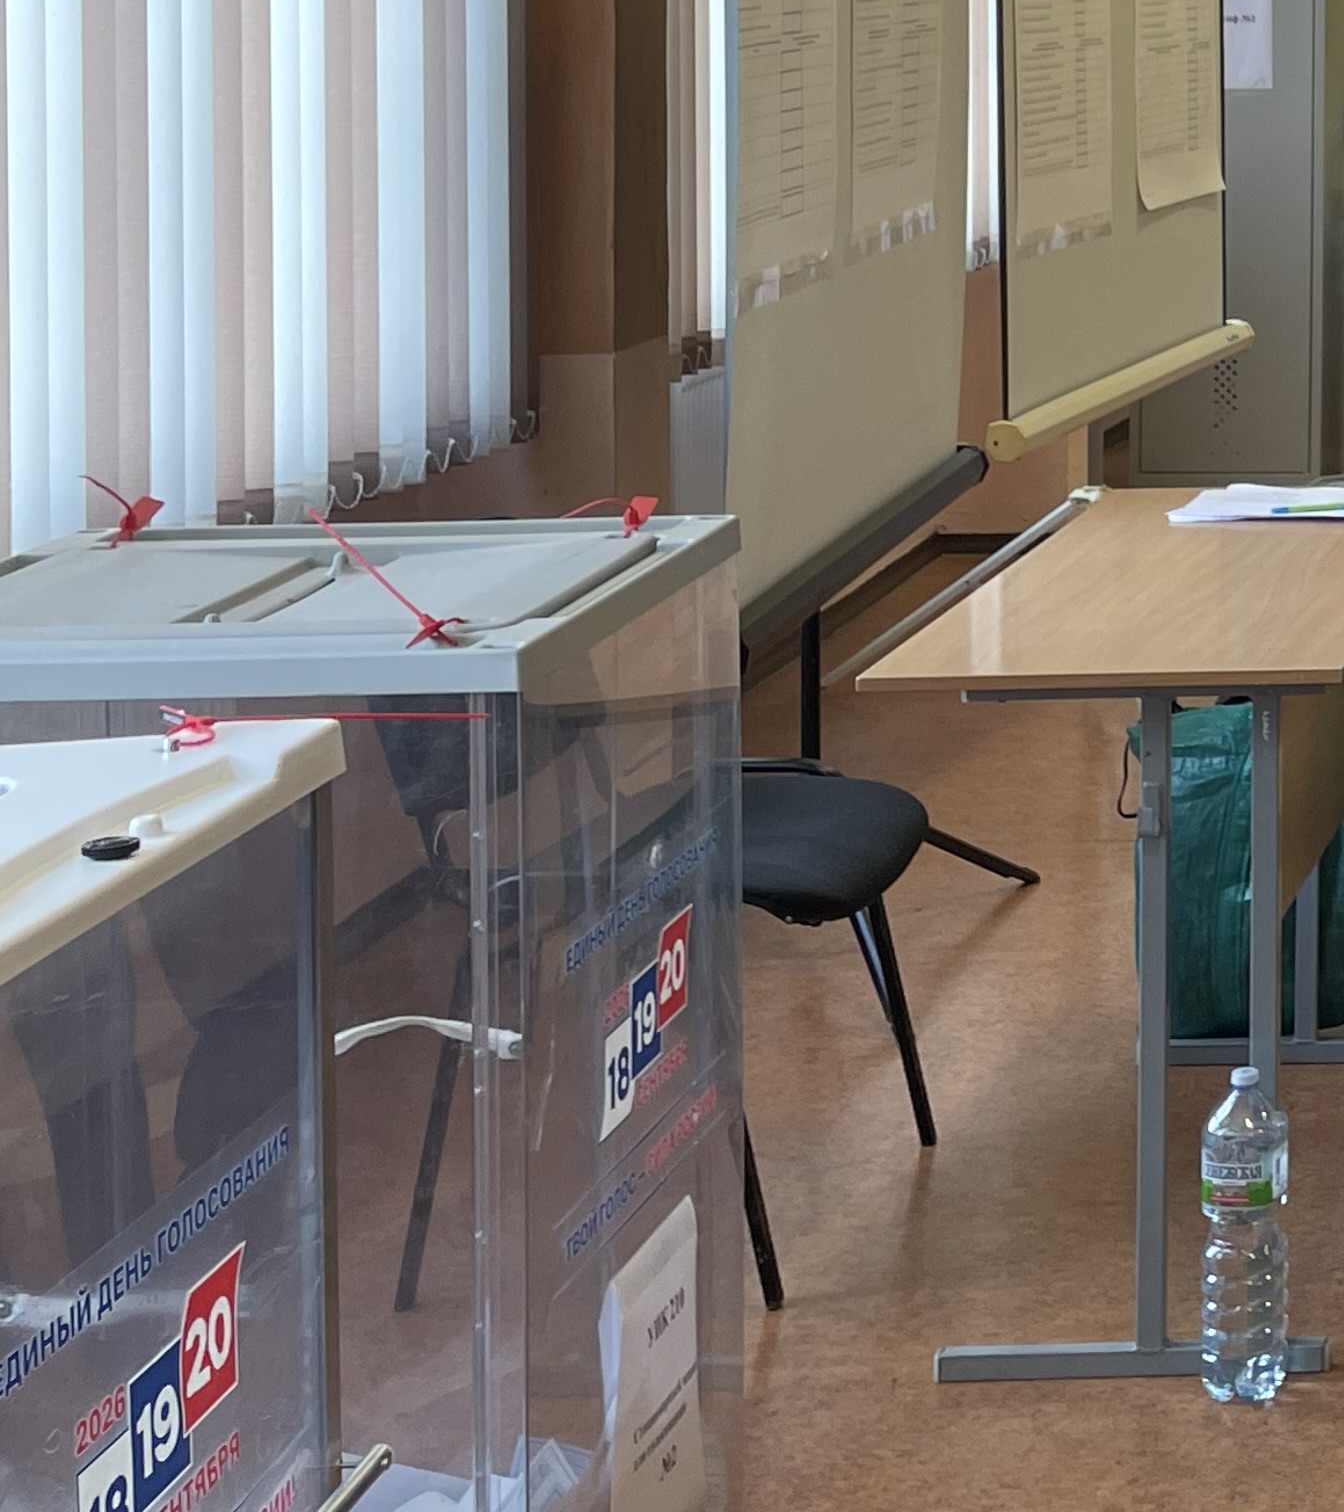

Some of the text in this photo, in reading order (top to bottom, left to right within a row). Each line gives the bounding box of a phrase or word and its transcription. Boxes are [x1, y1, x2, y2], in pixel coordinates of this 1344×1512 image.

[608, 938, 685, 1110] 18 19 20
[98, 1252, 152, 1320] ДЕНЬ
[157, 1125, 290, 1264] ГОЛОСОВАНИЯ
[75, 1385, 126, 1456] 2026
[136, 1384, 181, 1479] 19
[184, 1295, 231, 1398] 20
